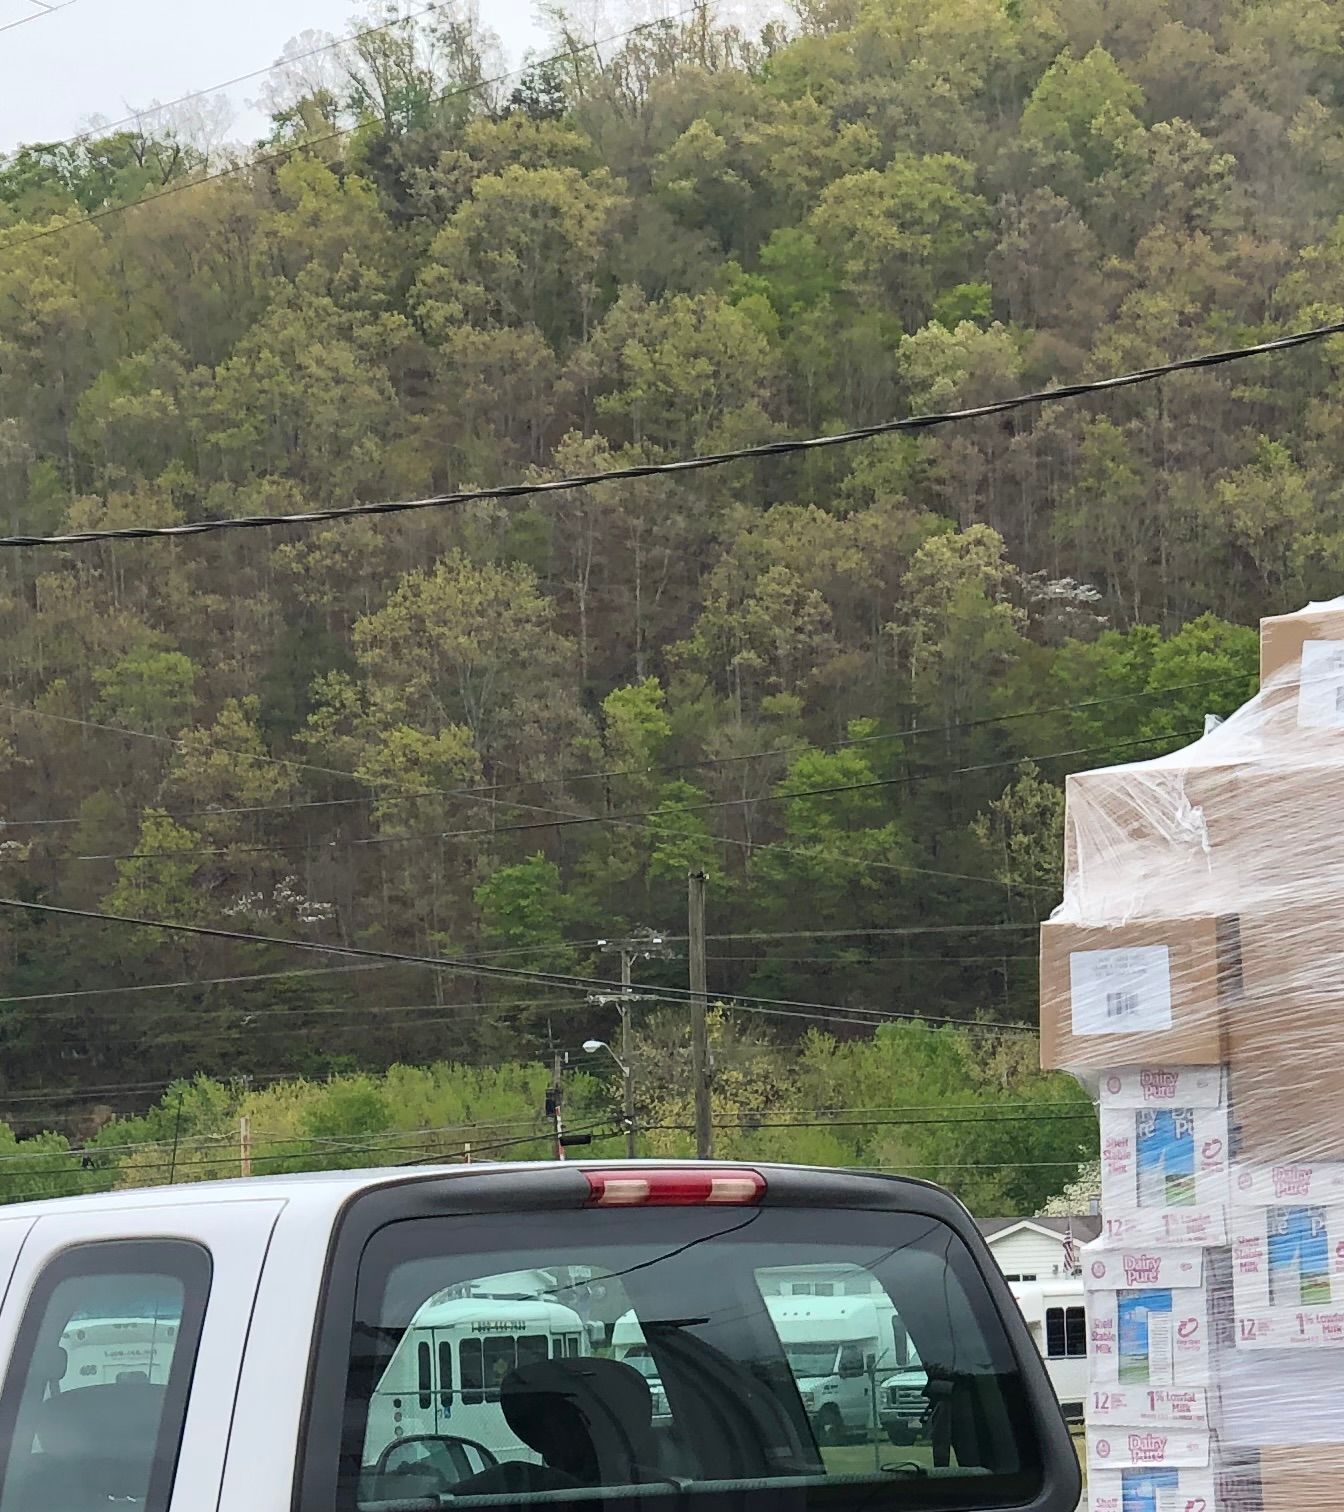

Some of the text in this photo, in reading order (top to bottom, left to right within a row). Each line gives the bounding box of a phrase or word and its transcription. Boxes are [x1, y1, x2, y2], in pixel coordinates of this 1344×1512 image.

[1140, 1069, 1179, 1087] Dairy
[1123, 1254, 1161, 1271] Dairy
[1126, 1270, 1160, 1286] Pure
[1239, 1318, 1256, 1337] 12
[1093, 1391, 1109, 1410] 12
[1128, 1434, 1168, 1452] Dairy
